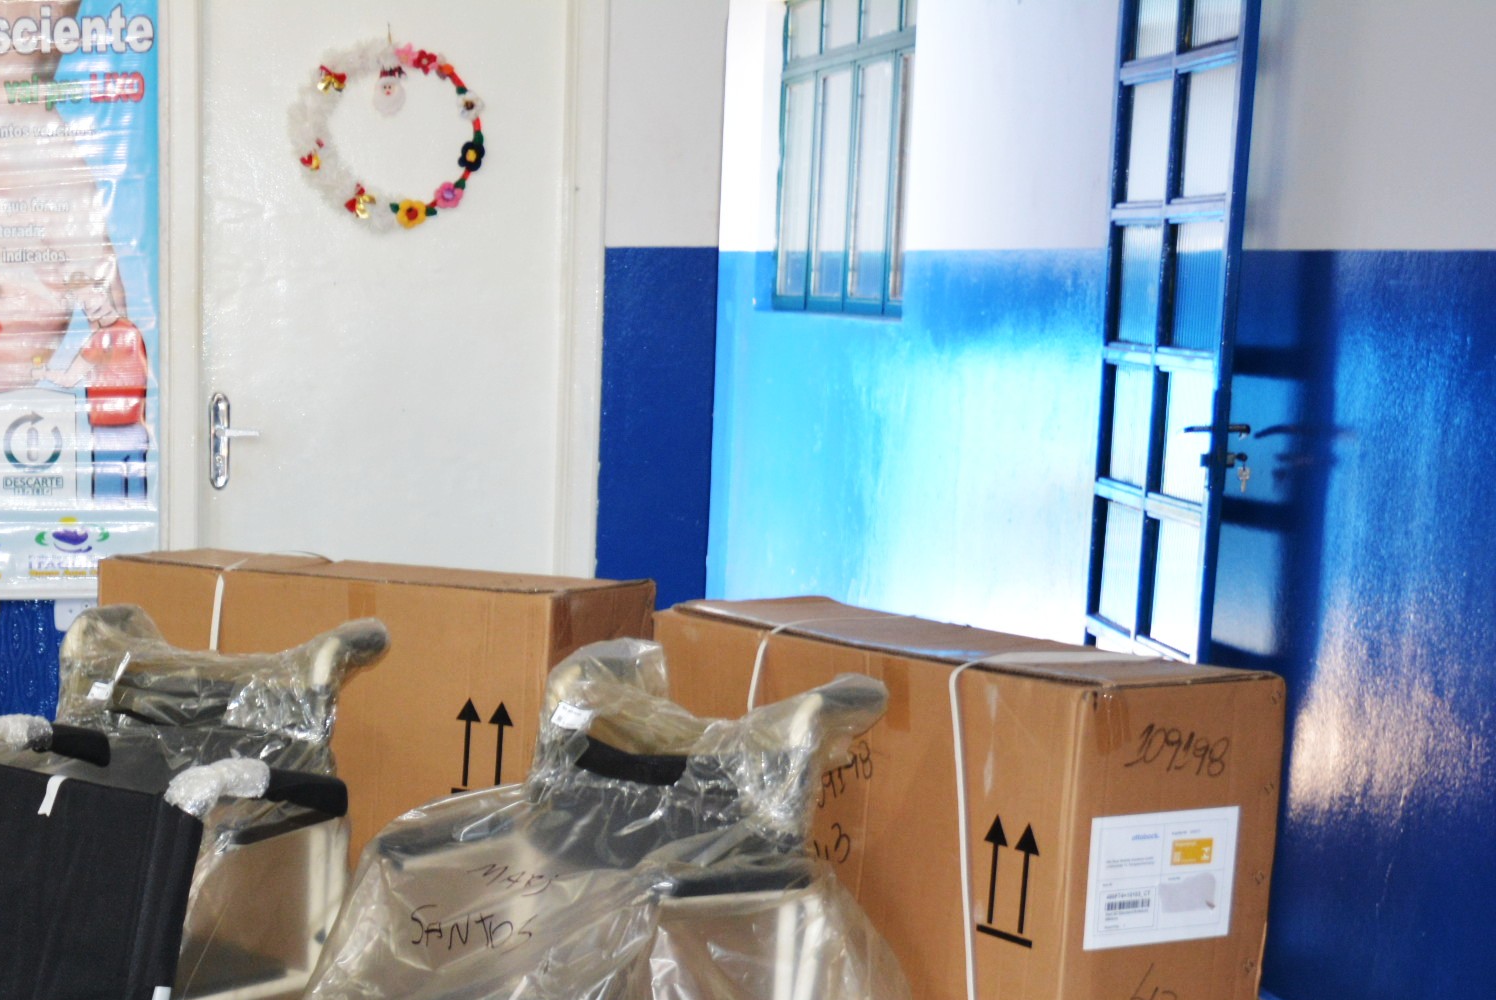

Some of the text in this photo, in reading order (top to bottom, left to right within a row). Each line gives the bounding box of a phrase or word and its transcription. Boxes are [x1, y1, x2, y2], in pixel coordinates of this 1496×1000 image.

[4, 72, 40, 104] vai
[89, 71, 145, 103] LIXO
[5, 200, 27, 217] que
[4, 475, 62, 489] DESCARTE
[410, 903, 539, 954] SANTOS
